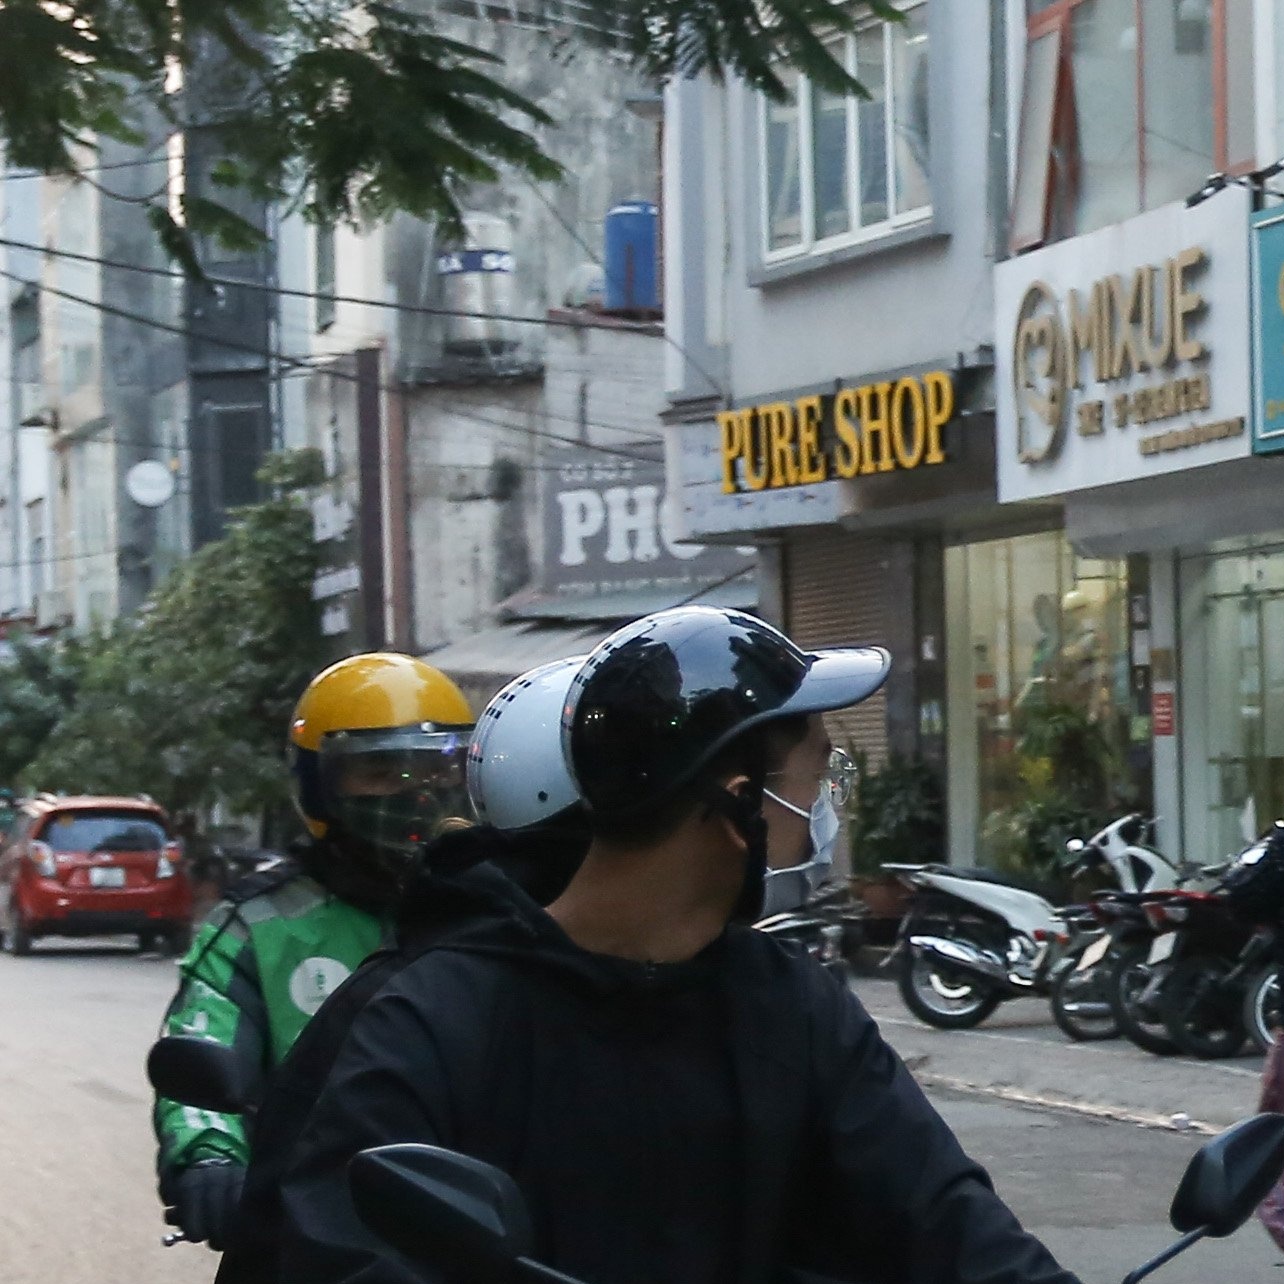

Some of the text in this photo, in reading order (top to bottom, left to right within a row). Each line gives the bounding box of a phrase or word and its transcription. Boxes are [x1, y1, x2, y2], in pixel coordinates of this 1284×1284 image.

[1066, 246, 1207, 390] MIXUE
[716, 395, 828, 495] PURE
[834, 370, 954, 479] SHOP
